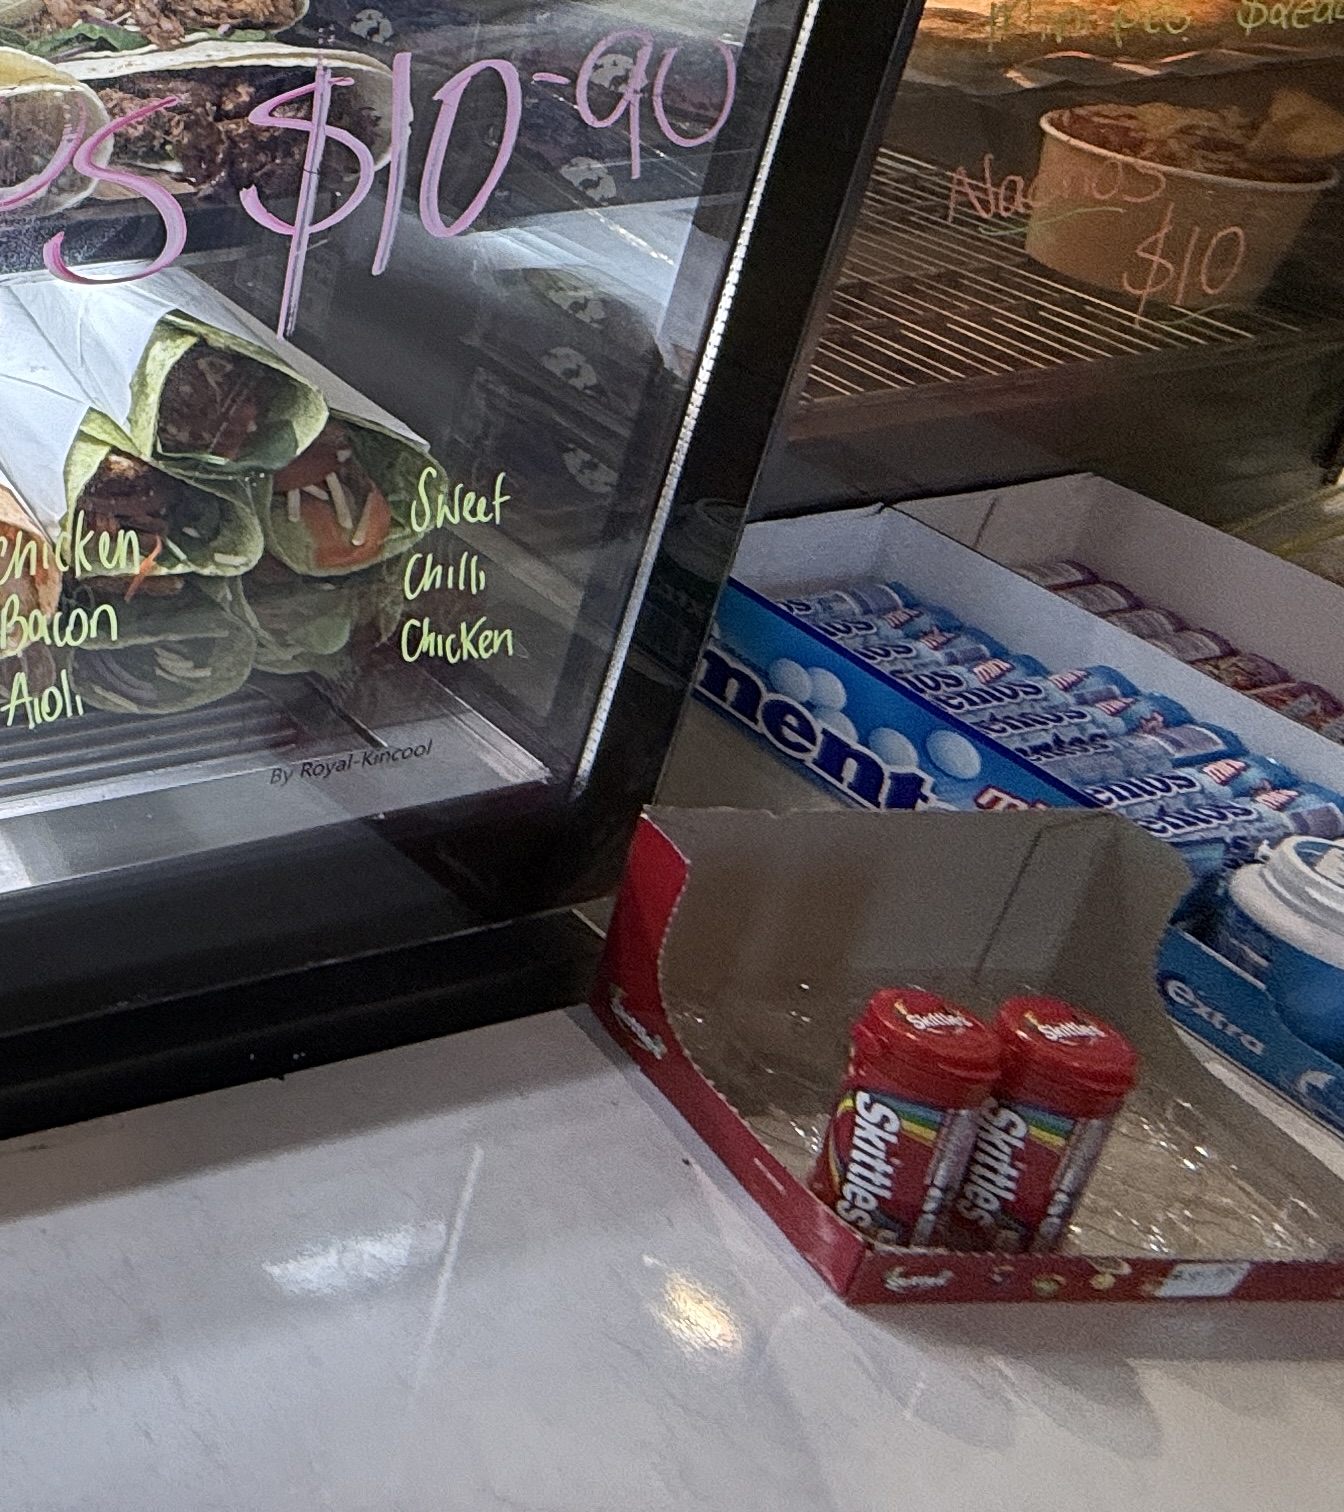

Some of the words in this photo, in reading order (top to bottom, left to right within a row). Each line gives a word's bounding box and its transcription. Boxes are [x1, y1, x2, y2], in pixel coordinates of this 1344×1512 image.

[1123, 201, 1246, 329] $10
[410, 464, 510, 533] Sweet
[400, 616, 515, 664] Chicken
[269, 768, 293, 787] By
[1165, 978, 1265, 1056] extra
[834, 1090, 901, 1229] Skittles
[958, 1096, 1029, 1228] Skittles
